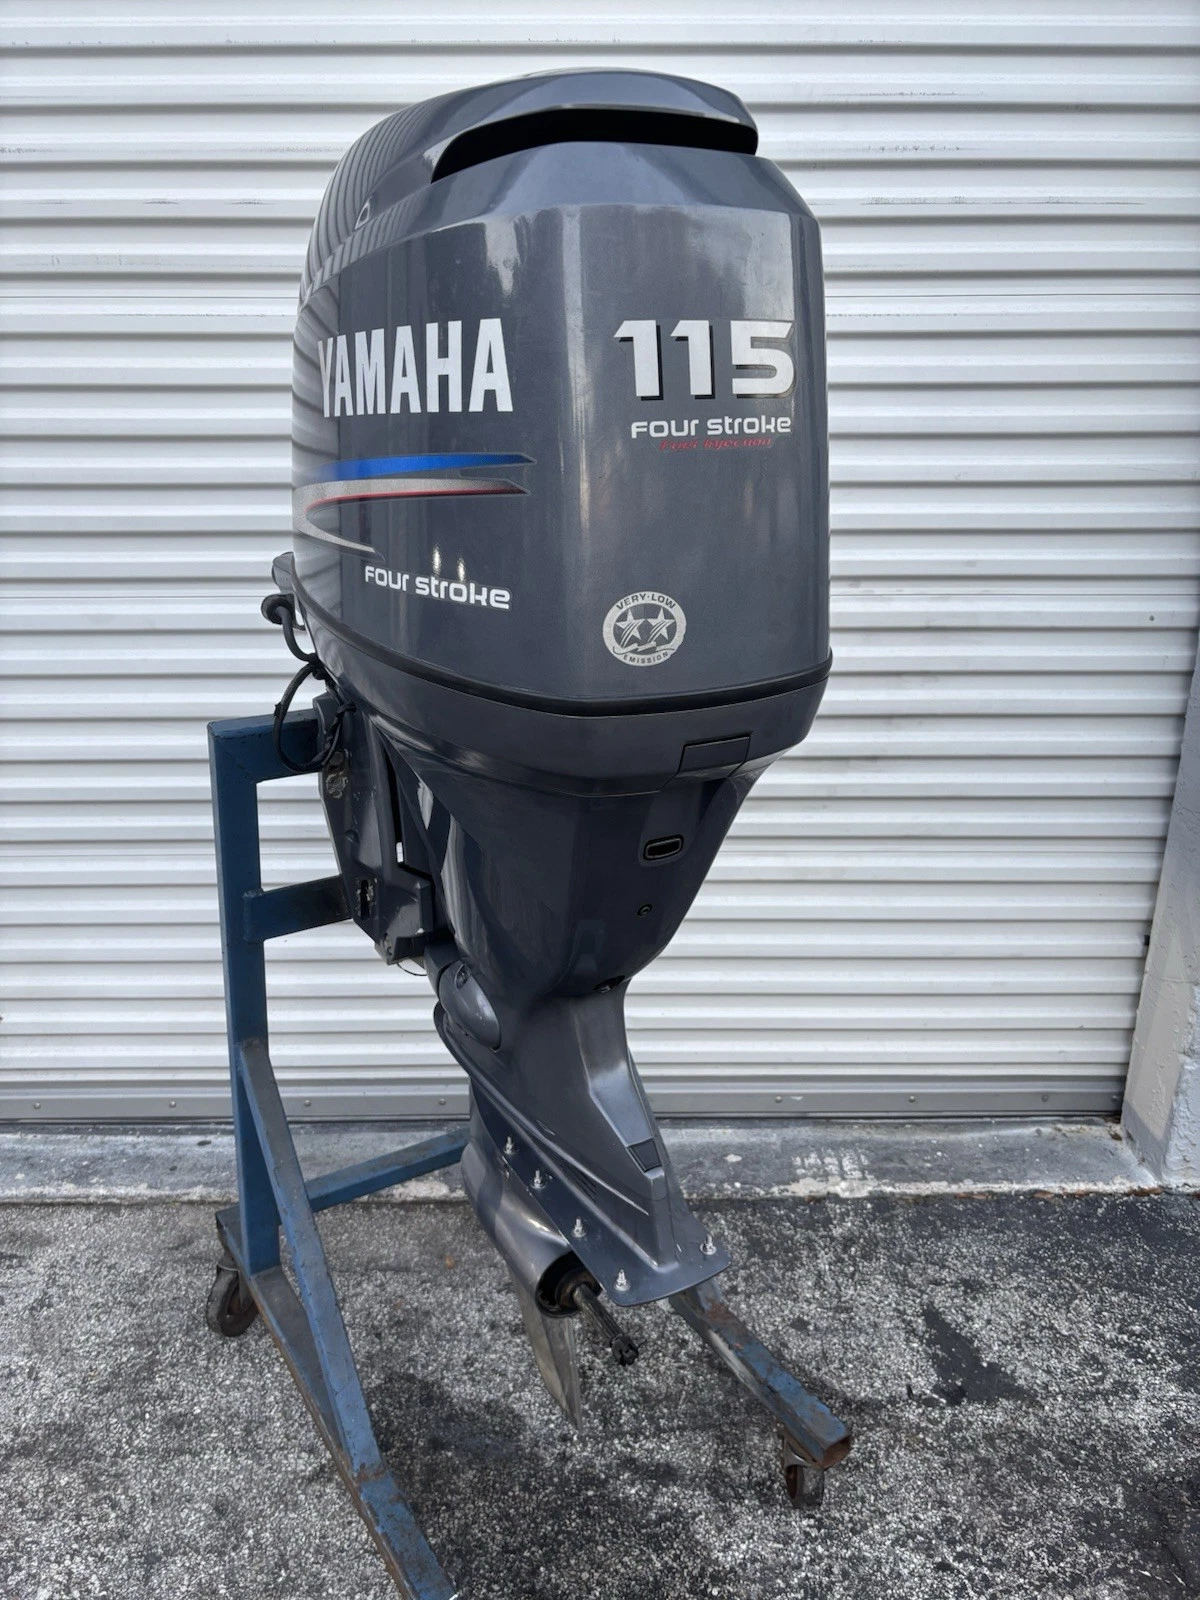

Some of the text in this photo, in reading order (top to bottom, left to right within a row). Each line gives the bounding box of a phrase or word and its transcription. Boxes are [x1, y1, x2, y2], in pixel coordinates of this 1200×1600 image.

[317, 317, 514, 418] YAMAHA
[613, 319, 796, 400] 115
[622, 651, 669, 664] EMISSION
